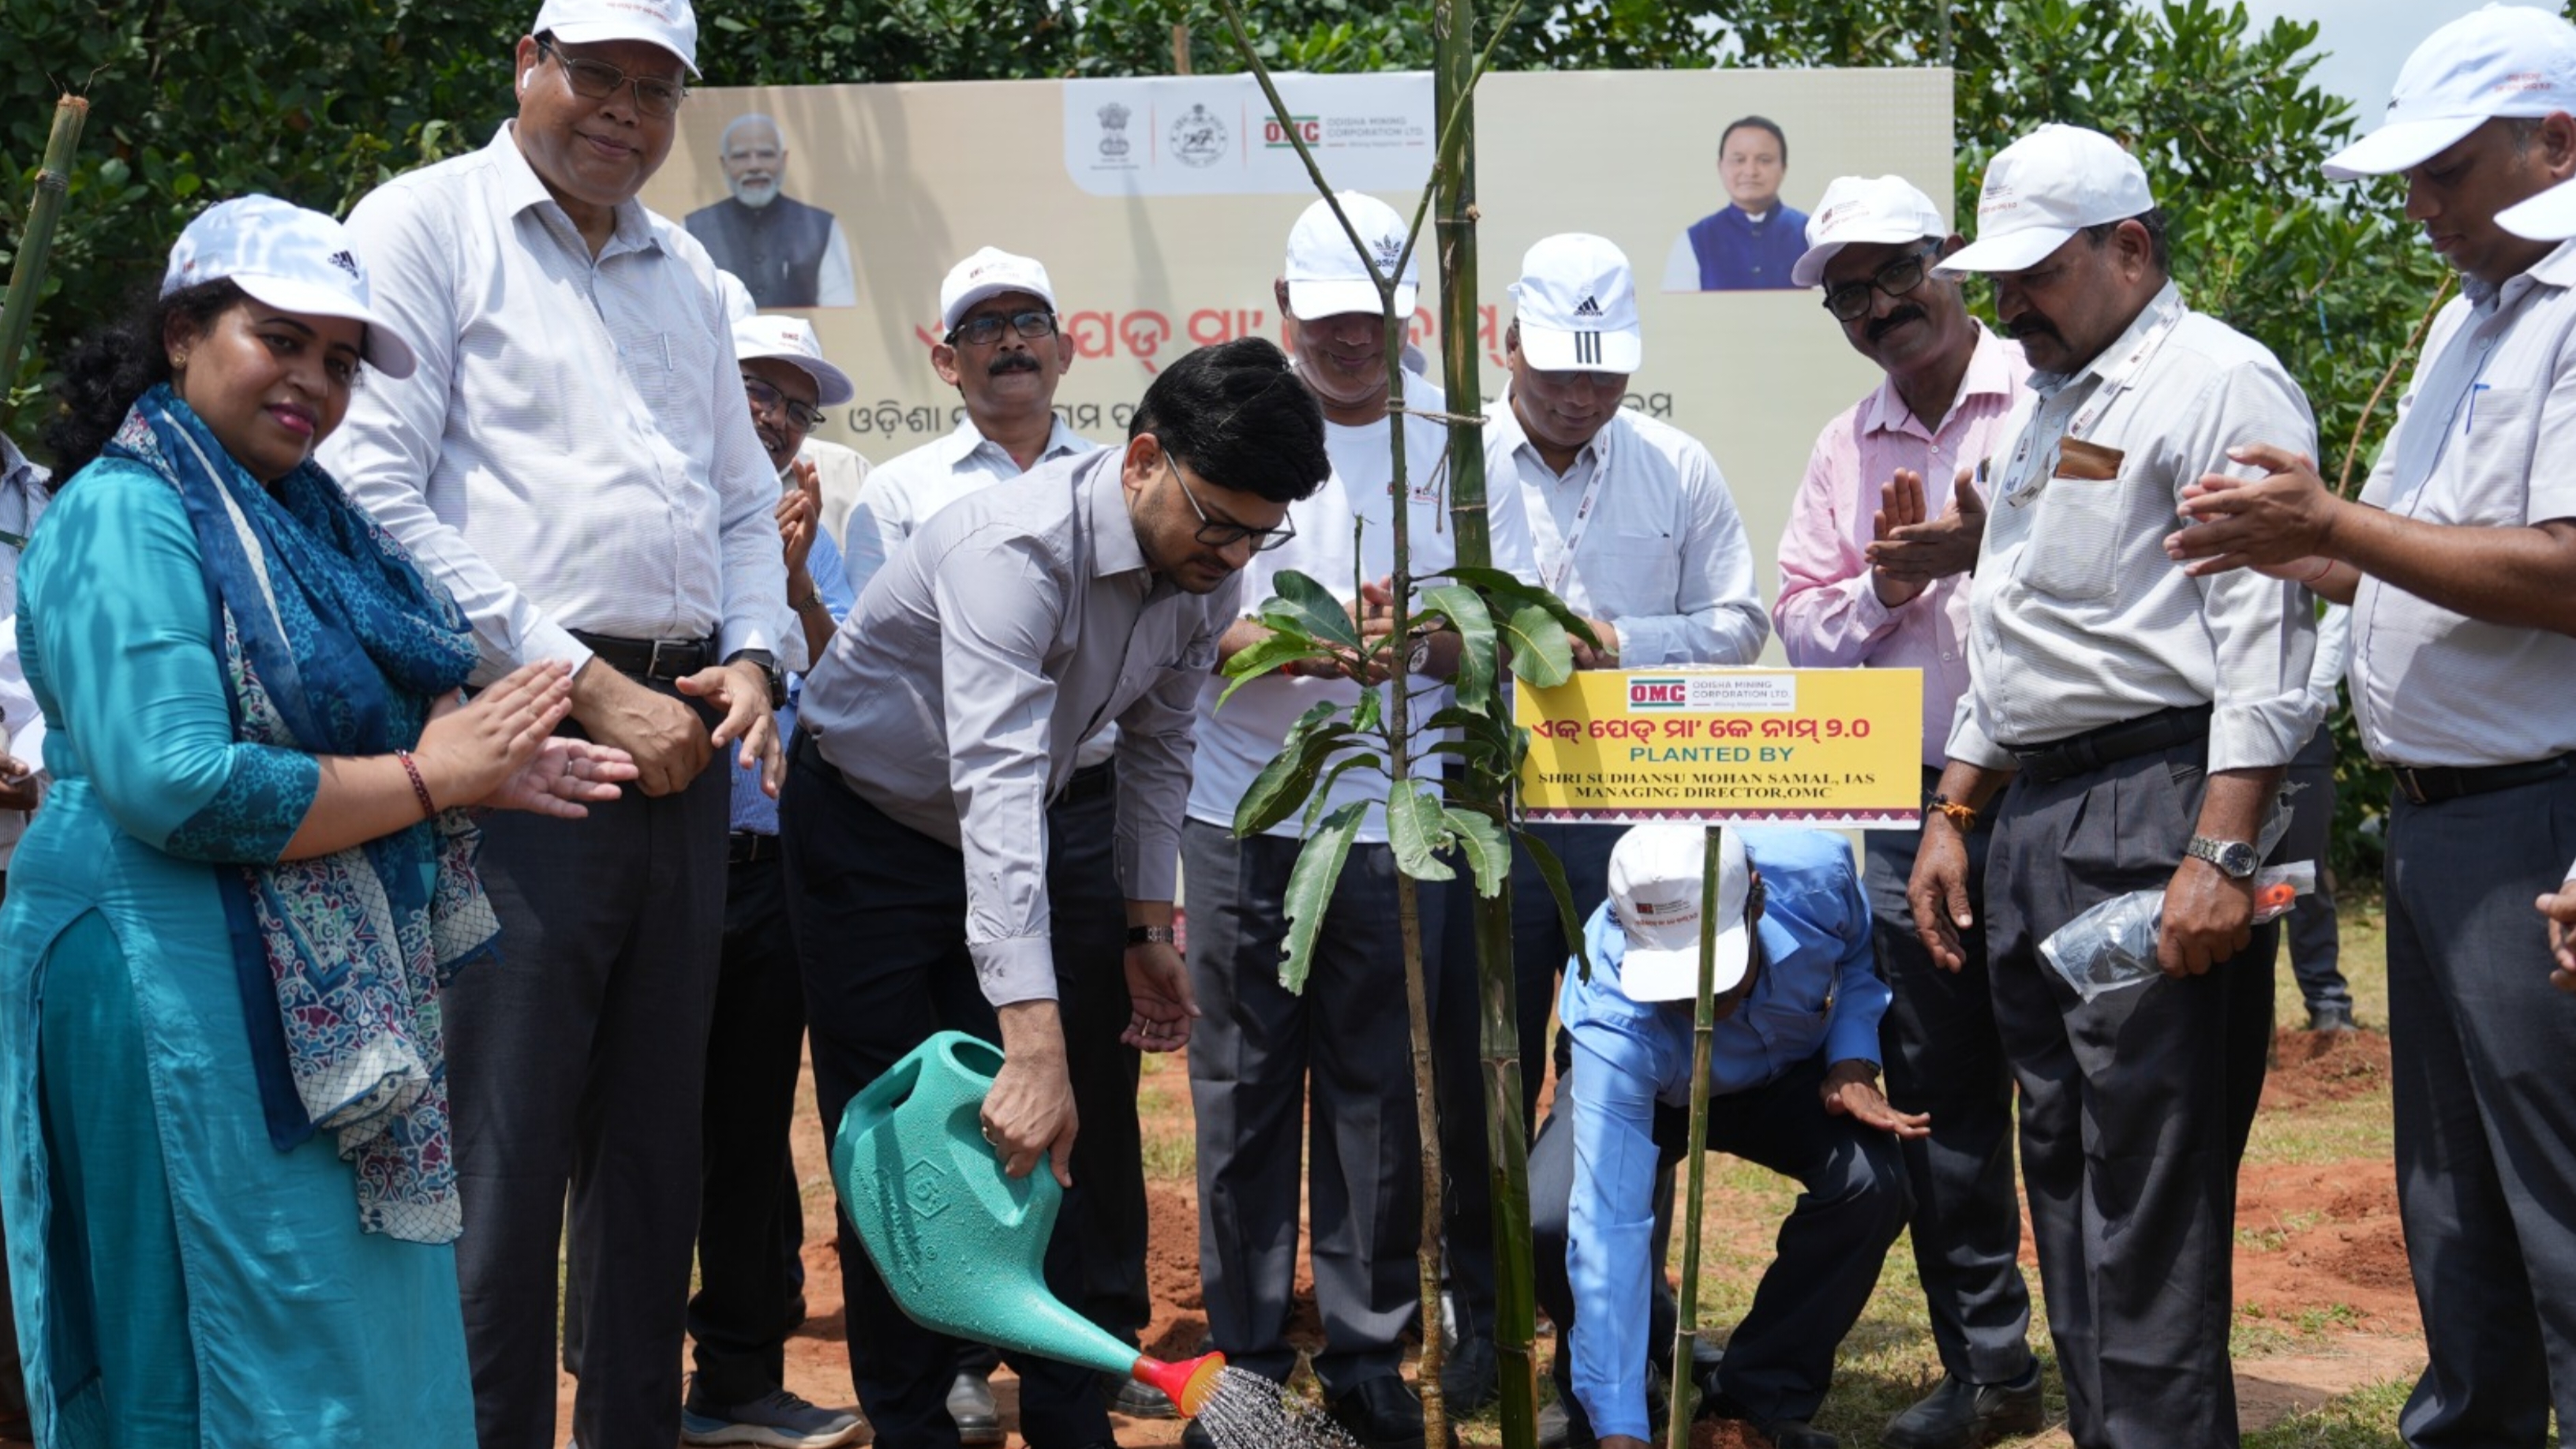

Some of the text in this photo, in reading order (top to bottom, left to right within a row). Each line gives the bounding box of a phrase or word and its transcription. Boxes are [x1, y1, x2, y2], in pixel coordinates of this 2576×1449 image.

[1265, 122, 1320, 143] OC
[1631, 684, 1686, 702] OMC
[1692, 690, 1768, 698] CORPORATION
[1532, 720, 1582, 744] ଏକ୍
[1709, 719, 1754, 738] କେ
[1631, 747, 1795, 762] PLANTED BY
[1537, 773, 1875, 785] SHRI SUDHANSU MOHAN SAMAL, IAS
[1575, 787, 1833, 799] MANAGING DIRECTOR,OMC
